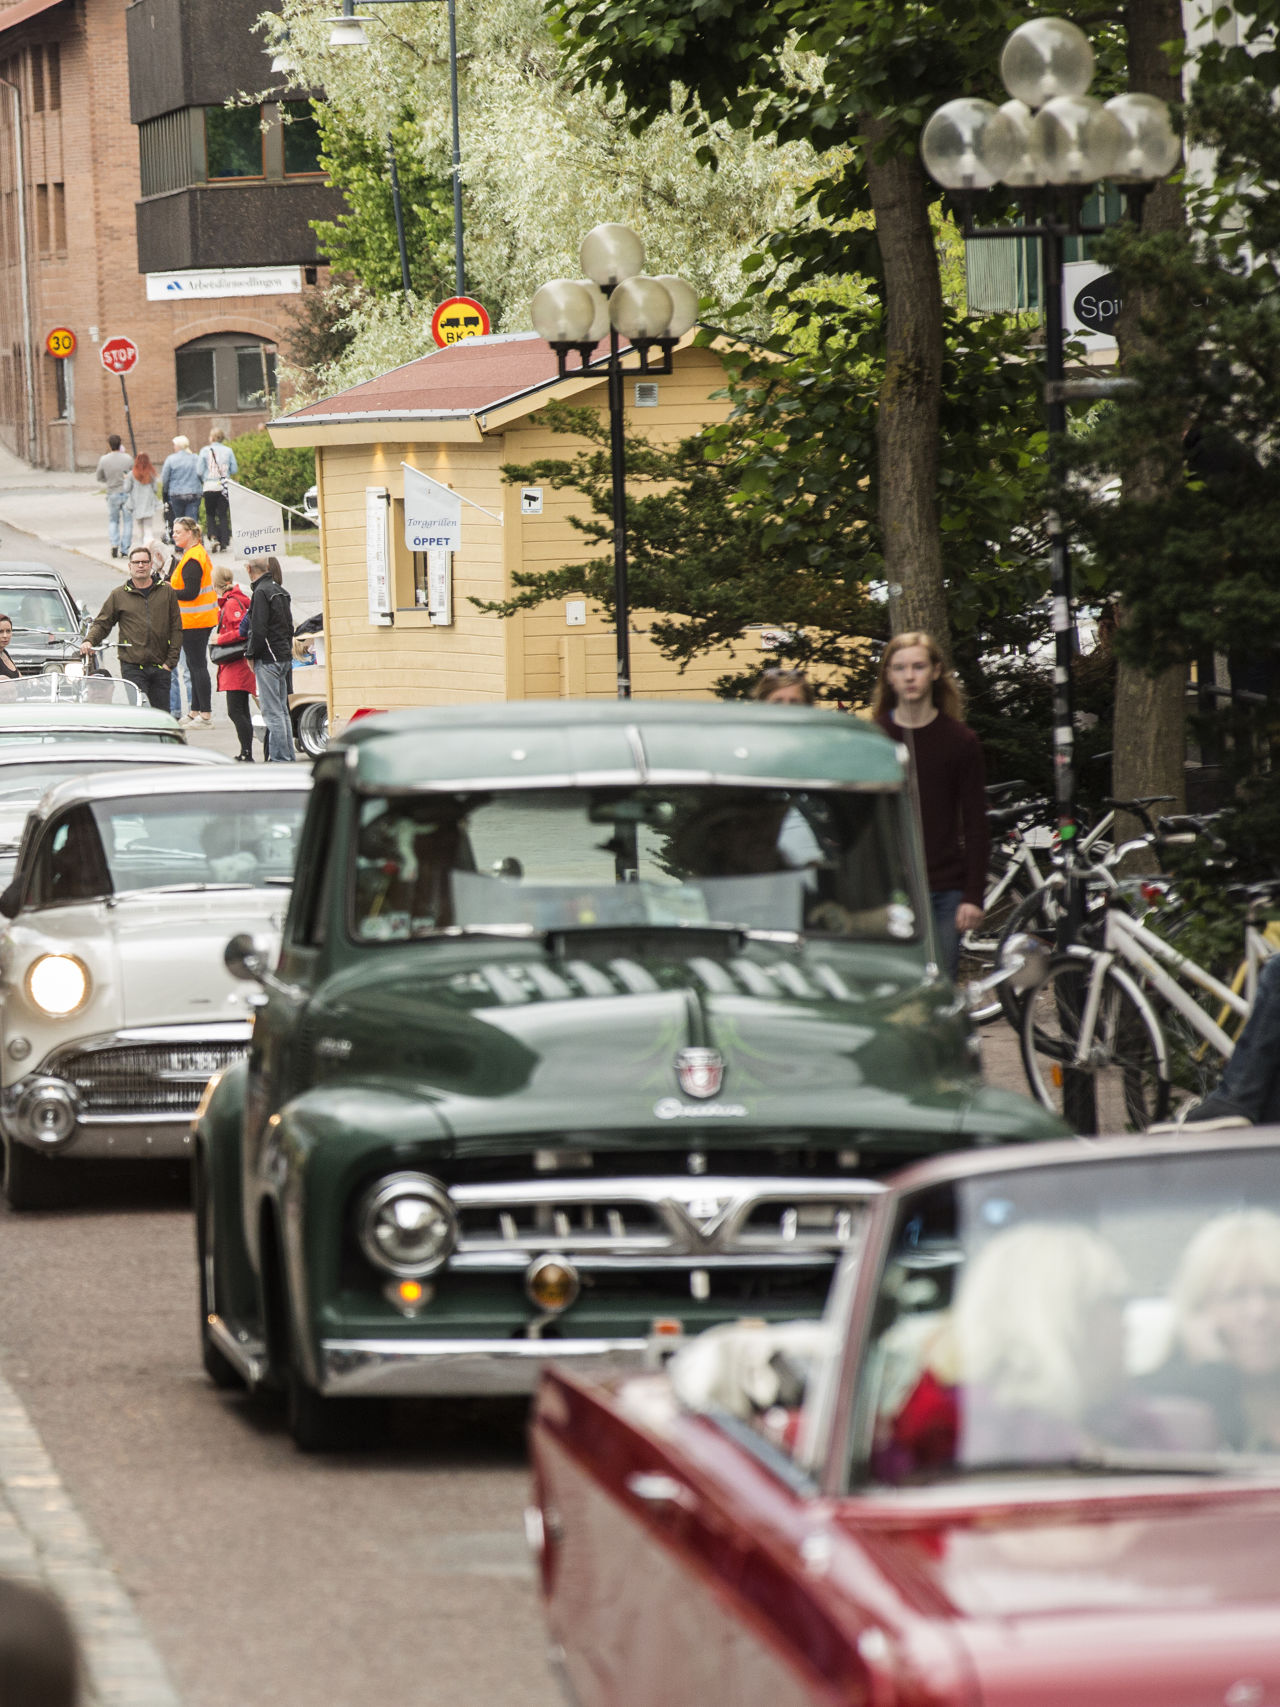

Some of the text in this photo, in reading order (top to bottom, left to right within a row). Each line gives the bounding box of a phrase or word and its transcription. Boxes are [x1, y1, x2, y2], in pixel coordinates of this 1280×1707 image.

[53, 336, 72, 351] 30
[103, 347, 135, 363] STOP
[407, 518, 457, 529] Torggrillen
[236, 526, 281, 538] Torggrillen
[413, 536, 451, 546] ÖPPET
[243, 543, 277, 555] ÖPPET
